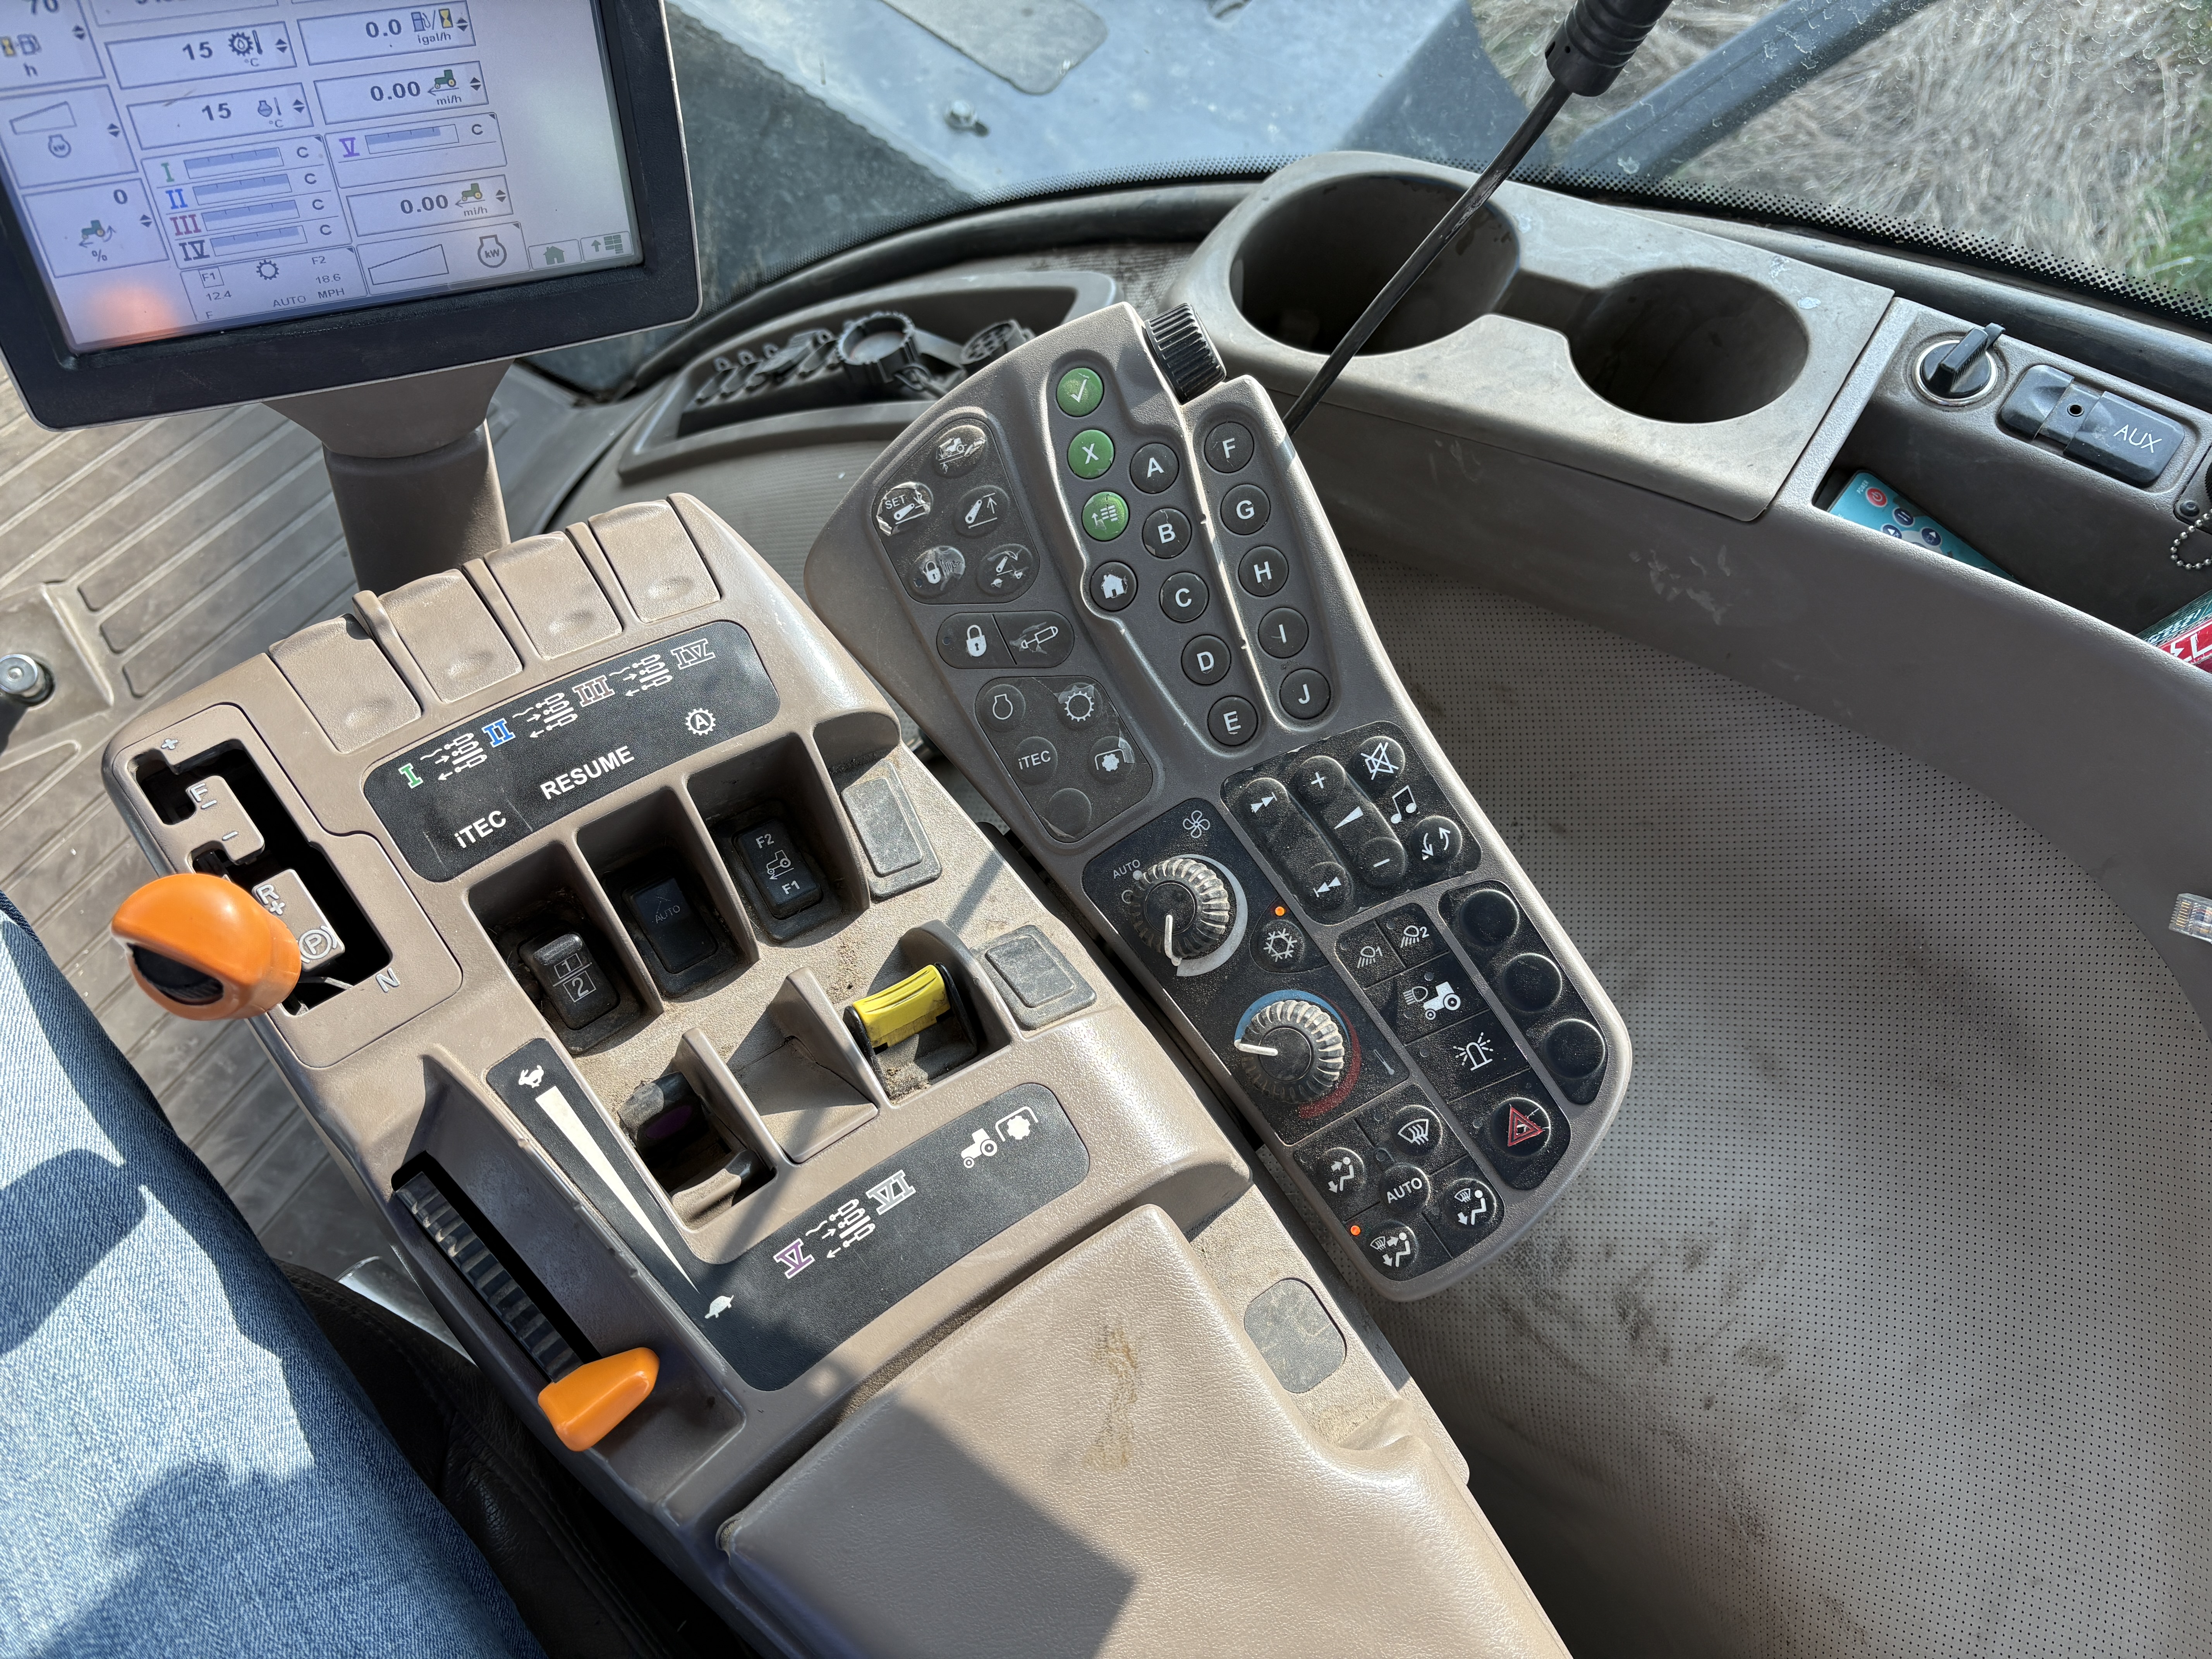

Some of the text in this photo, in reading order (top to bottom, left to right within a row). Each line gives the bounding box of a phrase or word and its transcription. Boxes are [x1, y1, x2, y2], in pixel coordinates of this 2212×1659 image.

[366, 19, 402, 38] 0.0
[417, 32, 452, 45] igal/h
[183, 41, 213, 60] 15
[23, 62, 38, 77] h
[370, 81, 421, 101] 0.00
[436, 94, 462, 106] mi/h
[202, 103, 232, 121] 15
[471, 124, 483, 135] C
[296, 147, 309, 158] C
[339, 137, 360, 158] V
[161, 163, 175, 183] I
[304, 173, 317, 185] C
[113, 189, 128, 204] 0
[165, 189, 189, 210] II
[312, 199, 324, 211] C
[400, 194, 449, 215] 0.00
[464, 205, 488, 216] mi/h
[170, 214, 202, 236] III
[319, 224, 332, 236] C
[179, 240, 210, 261] IV
[312, 256, 326, 264] F2
[484, 248, 500, 259] kW
[202, 272, 216, 282] F1
[316, 273, 341, 284] 18.6
[206, 290, 232, 301] 12.4
[273, 295, 306, 307] AUTO
[318, 288, 345, 299] MPH
[206, 311, 213, 319] F
[1222, 438, 1235, 459] F
[2113, 424, 2162, 453] AUX
[1147, 457, 1164, 478] A
[884, 495, 905, 510] SET
[1236, 500, 1255, 520] G
[1158, 523, 1176, 544] B
[1254, 561, 1272, 583] H
[1175, 588, 1192, 608] C
[1279, 624, 1287, 644] I
[670, 638, 716, 670] IV
[1197, 651, 1214, 672] D
[572, 675, 615, 708] III
[1298, 684, 1310, 704] J
[1223, 711, 1241, 732] E
[481, 718, 516, 748] II
[1018, 750, 1051, 770] iTEC
[540, 745, 635, 800] RESUME
[189, 783, 208, 802] F
[454, 810, 507, 848] iTEC
[756, 833, 775, 849] F2
[1112, 859, 1141, 879] AUTO
[256, 883, 279, 905] R
[781, 880, 800, 895] F1
[654, 905, 681, 924] AUTO
[1419, 926, 1430, 938] 2
[305, 934, 322, 954] P
[1375, 945, 1383, 958] 1
[376, 967, 400, 993] N
[572, 979, 588, 998] 2
[865, 1169, 917, 1216] VI
[1386, 1178, 1422, 1204] AUTO
[773, 1238, 816, 1279] V
